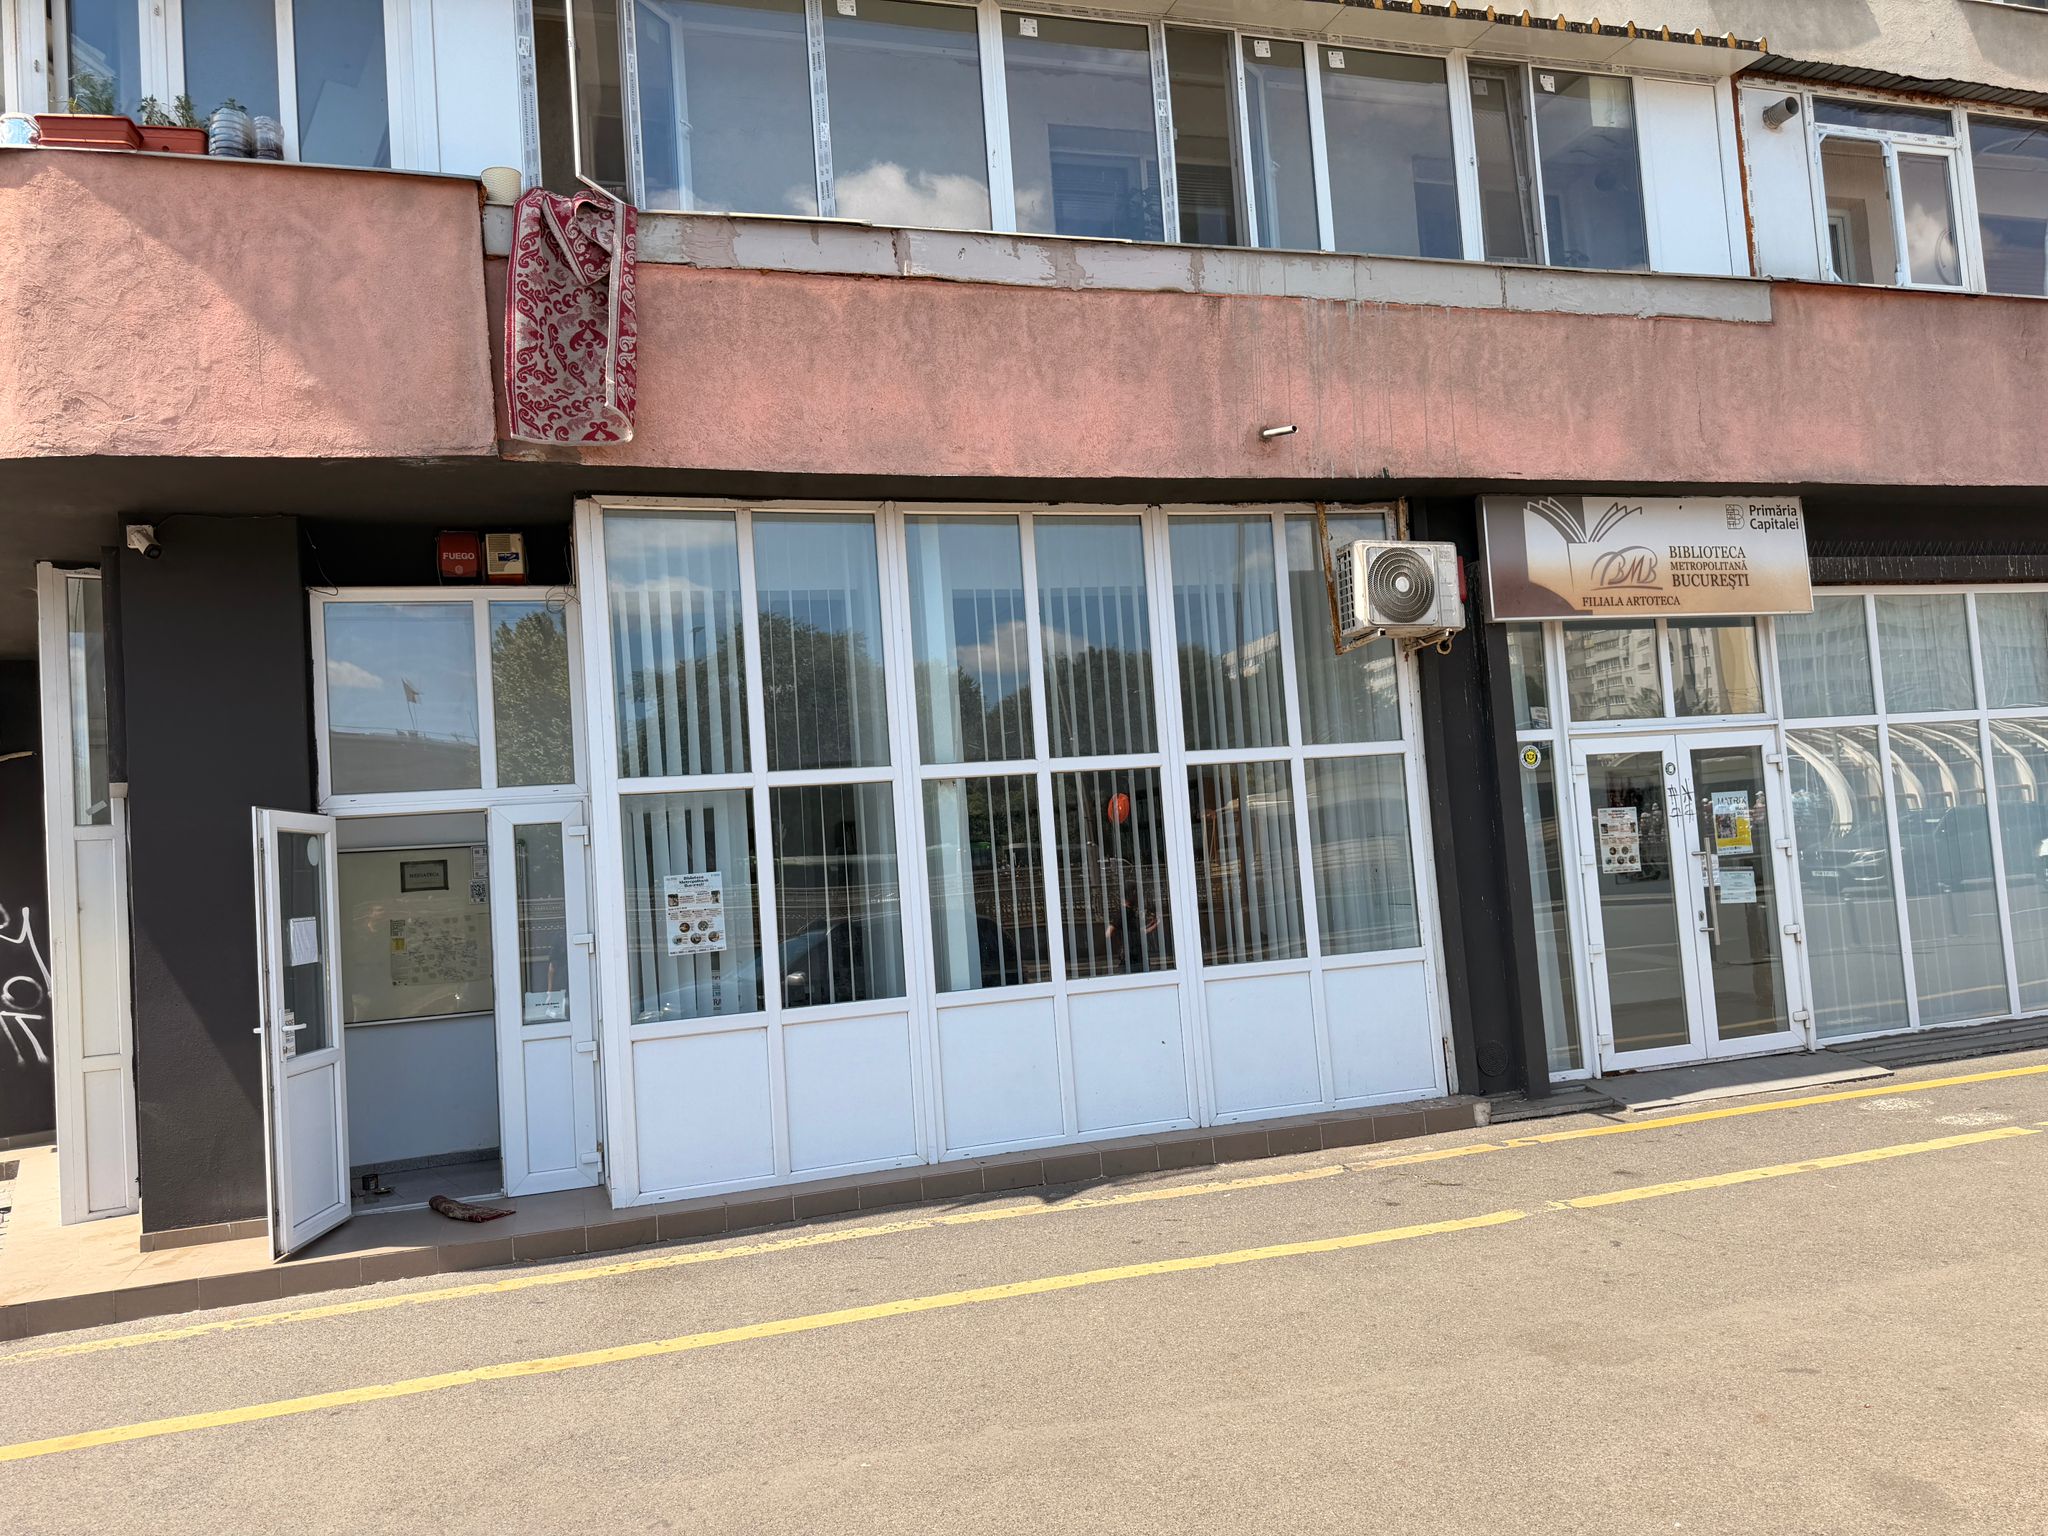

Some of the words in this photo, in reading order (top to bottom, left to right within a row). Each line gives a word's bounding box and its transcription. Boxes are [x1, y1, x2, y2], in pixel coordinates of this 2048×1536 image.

[1749, 504, 1797, 516] Primăria
[1750, 518, 1799, 533] Capitalei
[442, 552, 475, 560] FUEGO
[1669, 545, 1746, 559] BIBLIOTECA
[1670, 560, 1748, 571] METROPOLITANĂ
[1582, 597, 1624, 607] FILIALA
[1625, 596, 1681, 607] ARTOTECA
